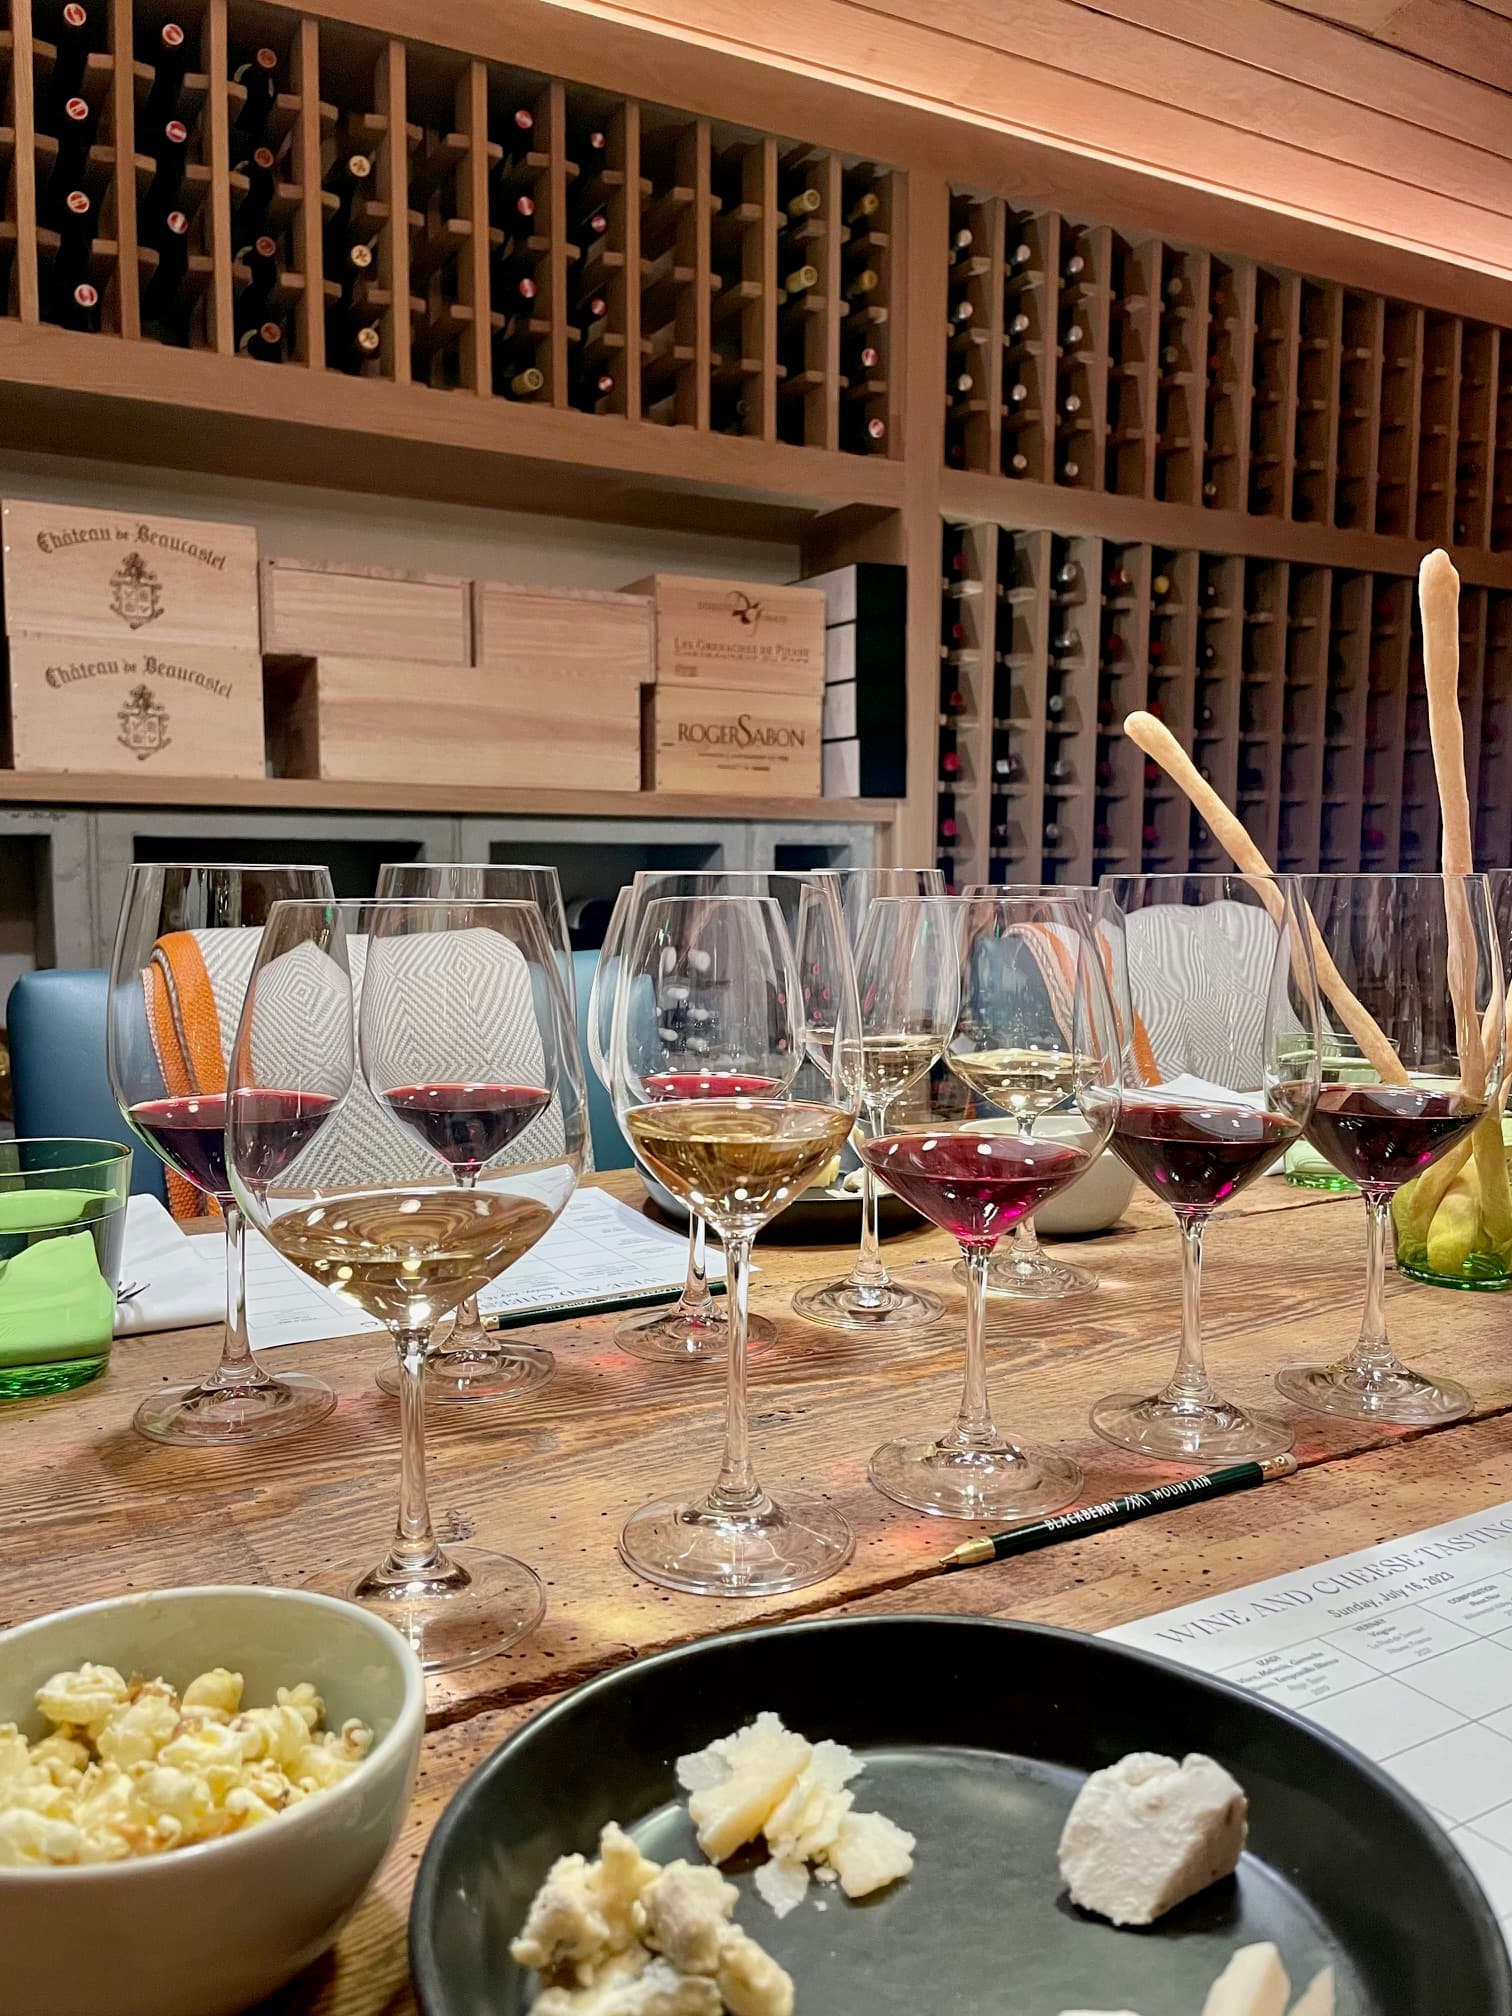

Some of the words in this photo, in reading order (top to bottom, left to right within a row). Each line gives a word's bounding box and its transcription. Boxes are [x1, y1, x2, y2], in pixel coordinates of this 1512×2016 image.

[135, 523, 226, 570] Beaucastel
[143, 654, 232, 699] Beaucastel
[1044, 1501, 1119, 1531] BLACKBERRY
[1151, 1475, 1212, 1501] MOUNTAIN
[1155, 1609, 1251, 1643] WINE
[1250, 1590, 1313, 1618] AND
[1312, 1553, 1424, 1595] CHEESE
[1328, 1598, 1383, 1619] Sunday,
[1382, 1585, 1409, 1602] July
[1405, 1582, 1429, 1593] 16,
[1423, 1571, 1455, 1586] 2023
